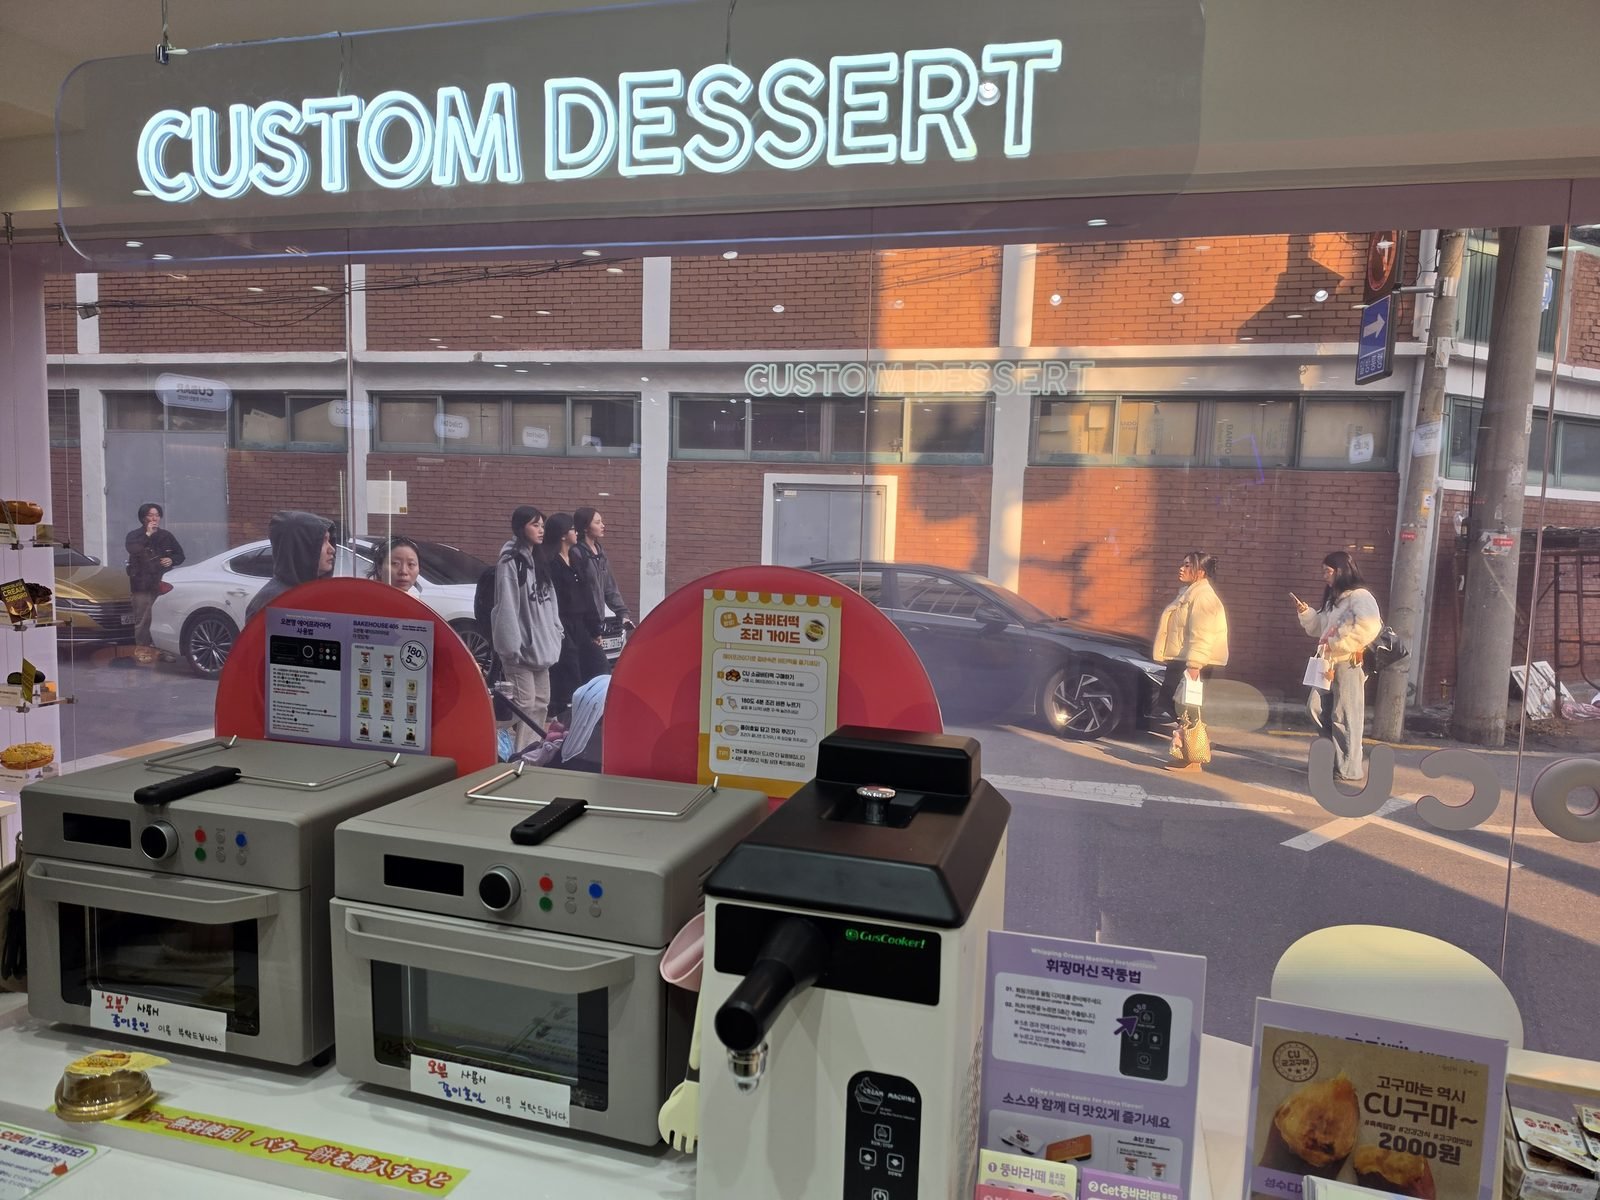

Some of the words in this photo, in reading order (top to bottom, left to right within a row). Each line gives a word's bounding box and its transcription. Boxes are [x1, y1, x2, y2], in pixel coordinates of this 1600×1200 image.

[135, 82, 522, 202] CUSTOM
[544, 39, 1062, 182] DESSERT
[744, 362, 904, 398] CUSTOM
[915, 360, 1095, 396] DESSERT
[353, 620, 389, 630] BAKEHOUSE
[742, 612, 800, 629] 소금버터떡
[740, 628, 763, 641] 조리
[766, 630, 801, 644] 가이드
[1031, 948, 1062, 958] Whipping
[1063, 950, 1085, 960] Cream
[1046, 958, 1099, 978] 휘핑머신
[1101, 966, 1141, 984] 작동법
[111, 1013, 149, 1033] 종이호일
[1287, 1050, 1300, 1058] CU
[428, 1059, 448, 1078] 오븐
[461, 1070, 487, 1085] 사용시
[438, 1081, 486, 1104] 종이호일
[496, 1095, 511, 1109] 이용
[1376, 1075, 1434, 1098] 고구마는
[1437, 1087, 1466, 1104] 역시
[1002, 1092, 1040, 1109] 소스와
[1041, 1097, 1066, 1113] 함께
[1068, 1102, 1080, 1116] 더
[1082, 1104, 1120, 1122] 맛있게
[1122, 1110, 1171, 1129] 즐기세요
[1378, 1132, 1461, 1166] 2000원
[1000, 1162, 1046, 1184] 뚱바라떼
